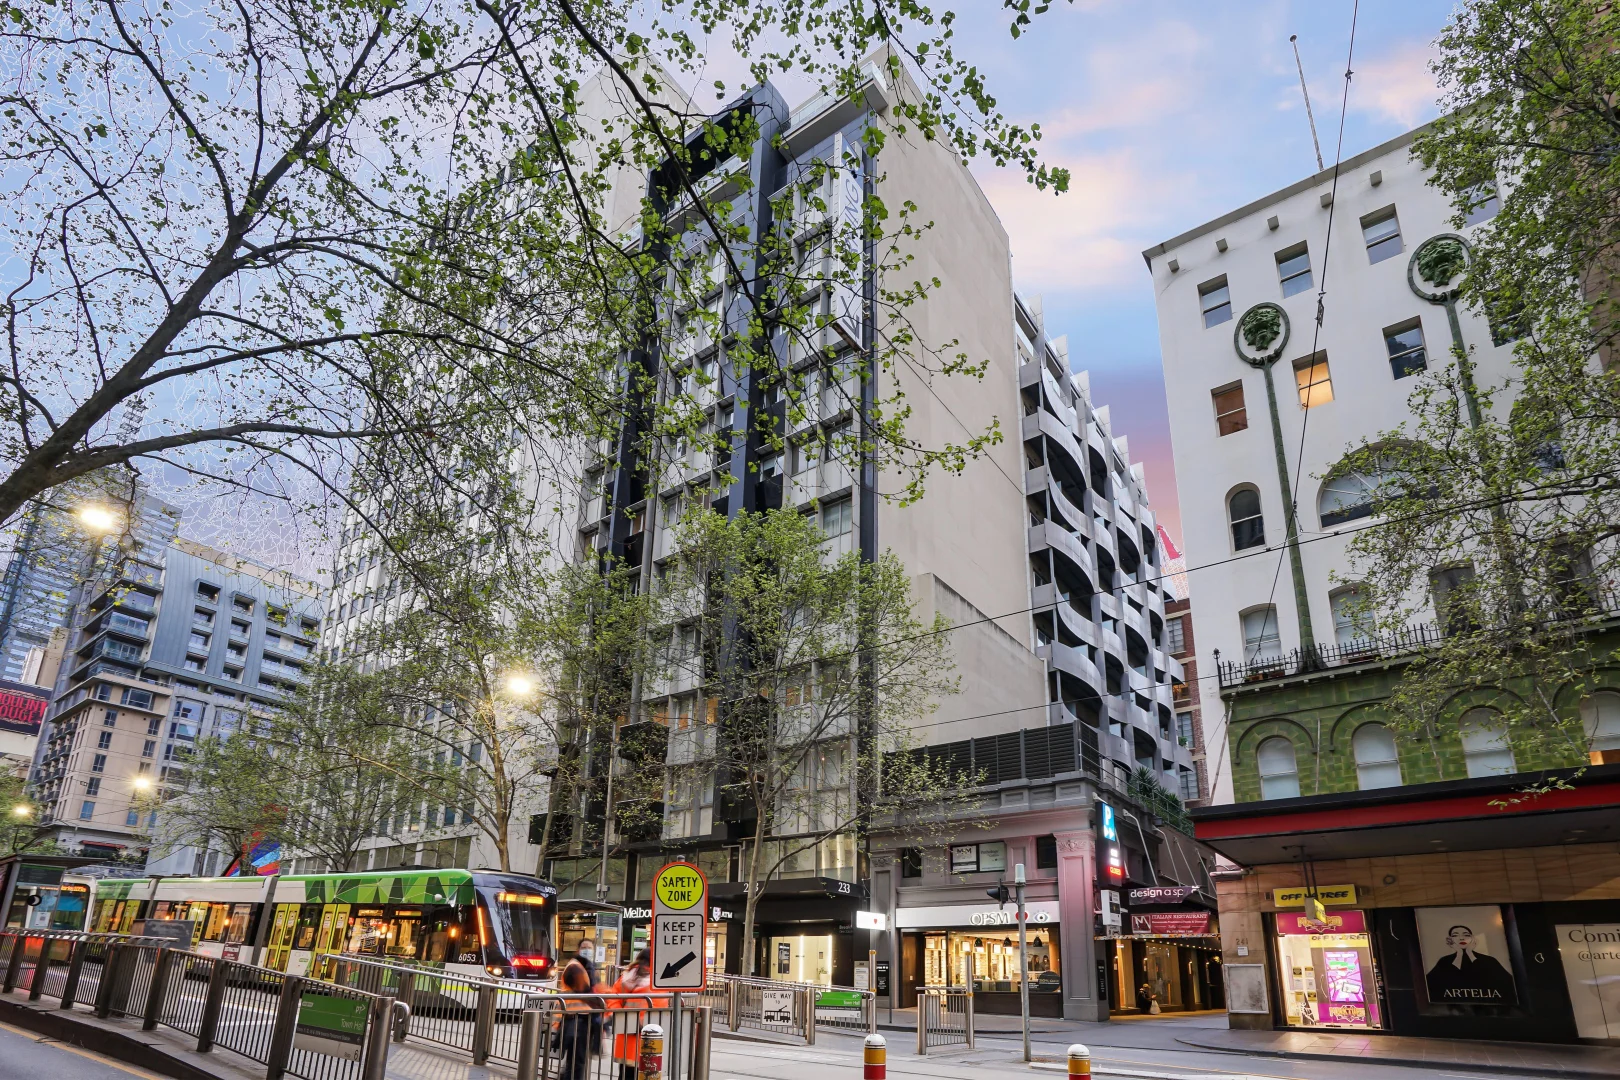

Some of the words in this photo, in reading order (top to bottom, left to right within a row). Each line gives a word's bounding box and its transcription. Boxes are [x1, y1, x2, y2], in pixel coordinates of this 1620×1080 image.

[0, 692, 40, 712] OULIN
[662, 876, 698, 888] SAFETY
[544, 886, 557, 895] 6053
[838, 882, 851, 894] 233
[1130, 888, 1163, 898] design
[667, 890, 693, 902] ZONE
[1280, 893, 1302, 901] OFF
[1320, 890, 1349, 899] TREE
[720, 911, 733, 919] ATM
[969, 912, 1011, 926] OPSM
[662, 921, 696, 932] KEEP
[663, 935, 694, 945] LEFT
[458, 953, 476, 963] 6053
[1443, 988, 1502, 998] ARTELIA
[527, 1000, 544, 1010] GIVE
[341, 1018, 354, 1030] Town
[354, 1020, 364, 1031] Hall
[353, 1049, 359, 1061] 6
